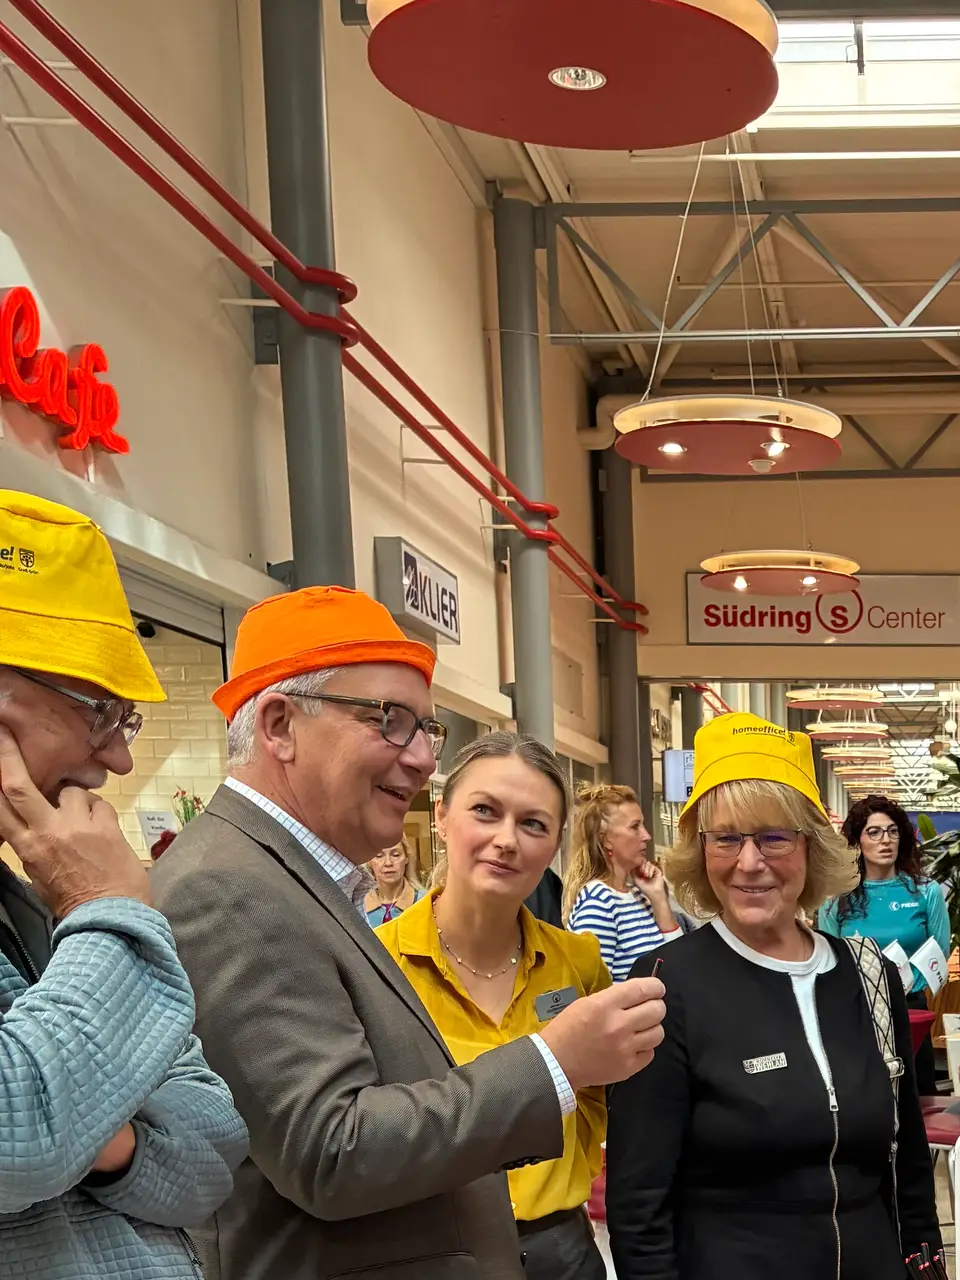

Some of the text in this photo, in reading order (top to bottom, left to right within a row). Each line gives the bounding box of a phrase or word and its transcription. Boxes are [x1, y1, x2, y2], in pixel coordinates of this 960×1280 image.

[419, 571, 458, 633] KLIER
[703, 604, 812, 634] Südring
[867, 605, 945, 629] Center
